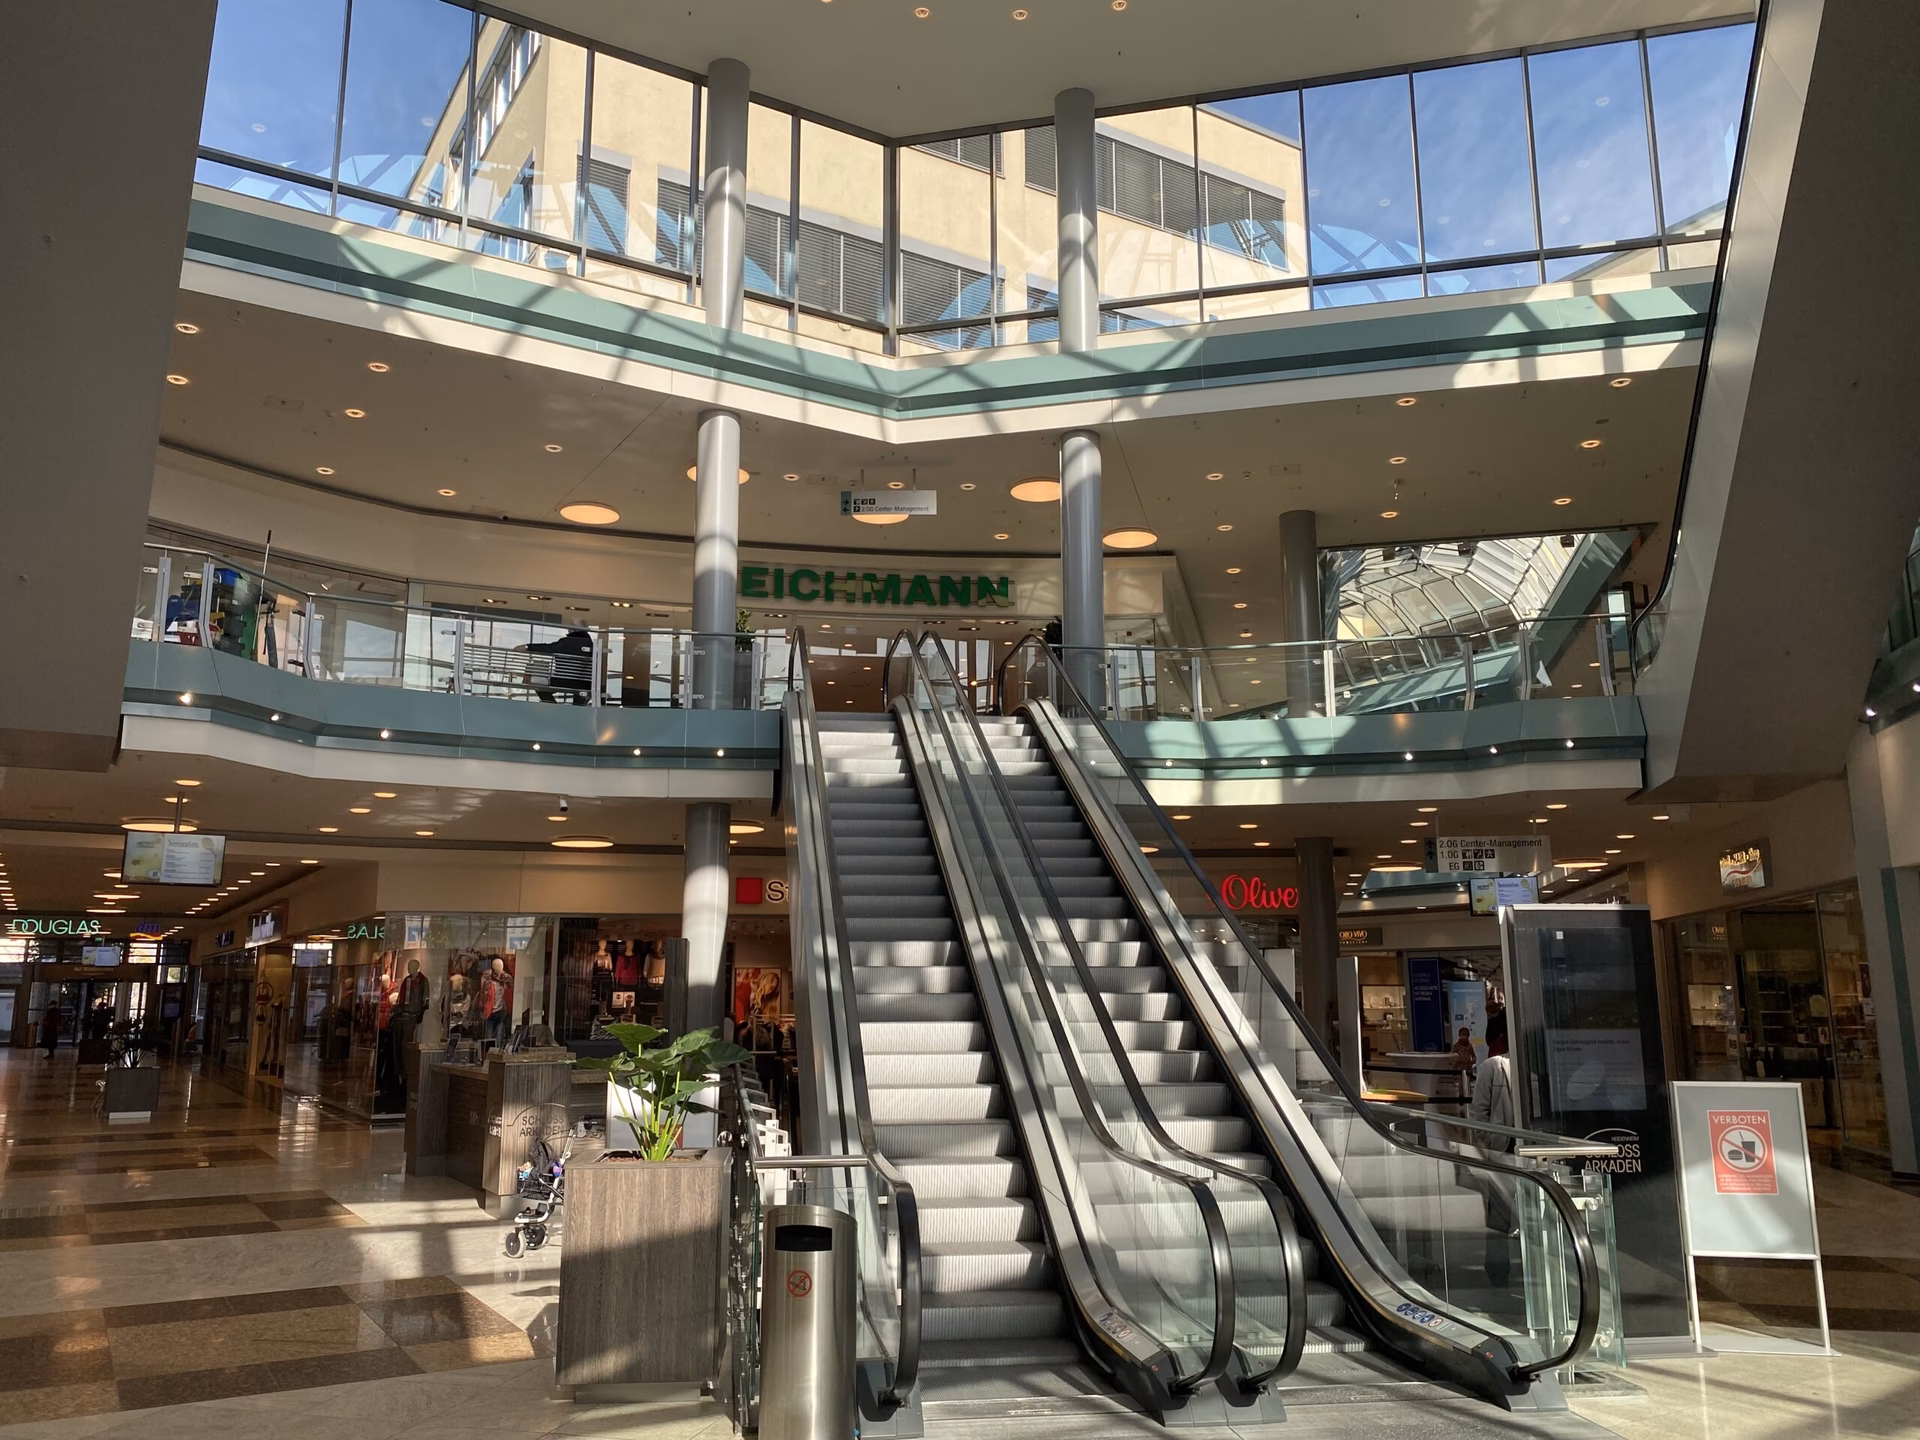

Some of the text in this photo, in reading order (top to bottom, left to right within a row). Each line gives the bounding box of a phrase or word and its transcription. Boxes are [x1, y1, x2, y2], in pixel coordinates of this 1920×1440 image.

[741, 566, 1009, 608] EICHMANN
[1460, 839, 1542, 849] Center-Management
[1449, 862, 1460, 871] EG
[1221, 874, 1299, 911] Olive
[12, 919, 101, 935] DOUGLAS
[1712, 1115, 1766, 1124] VERBOTEN
[1584, 1159, 1642, 1173] ARKADEN
